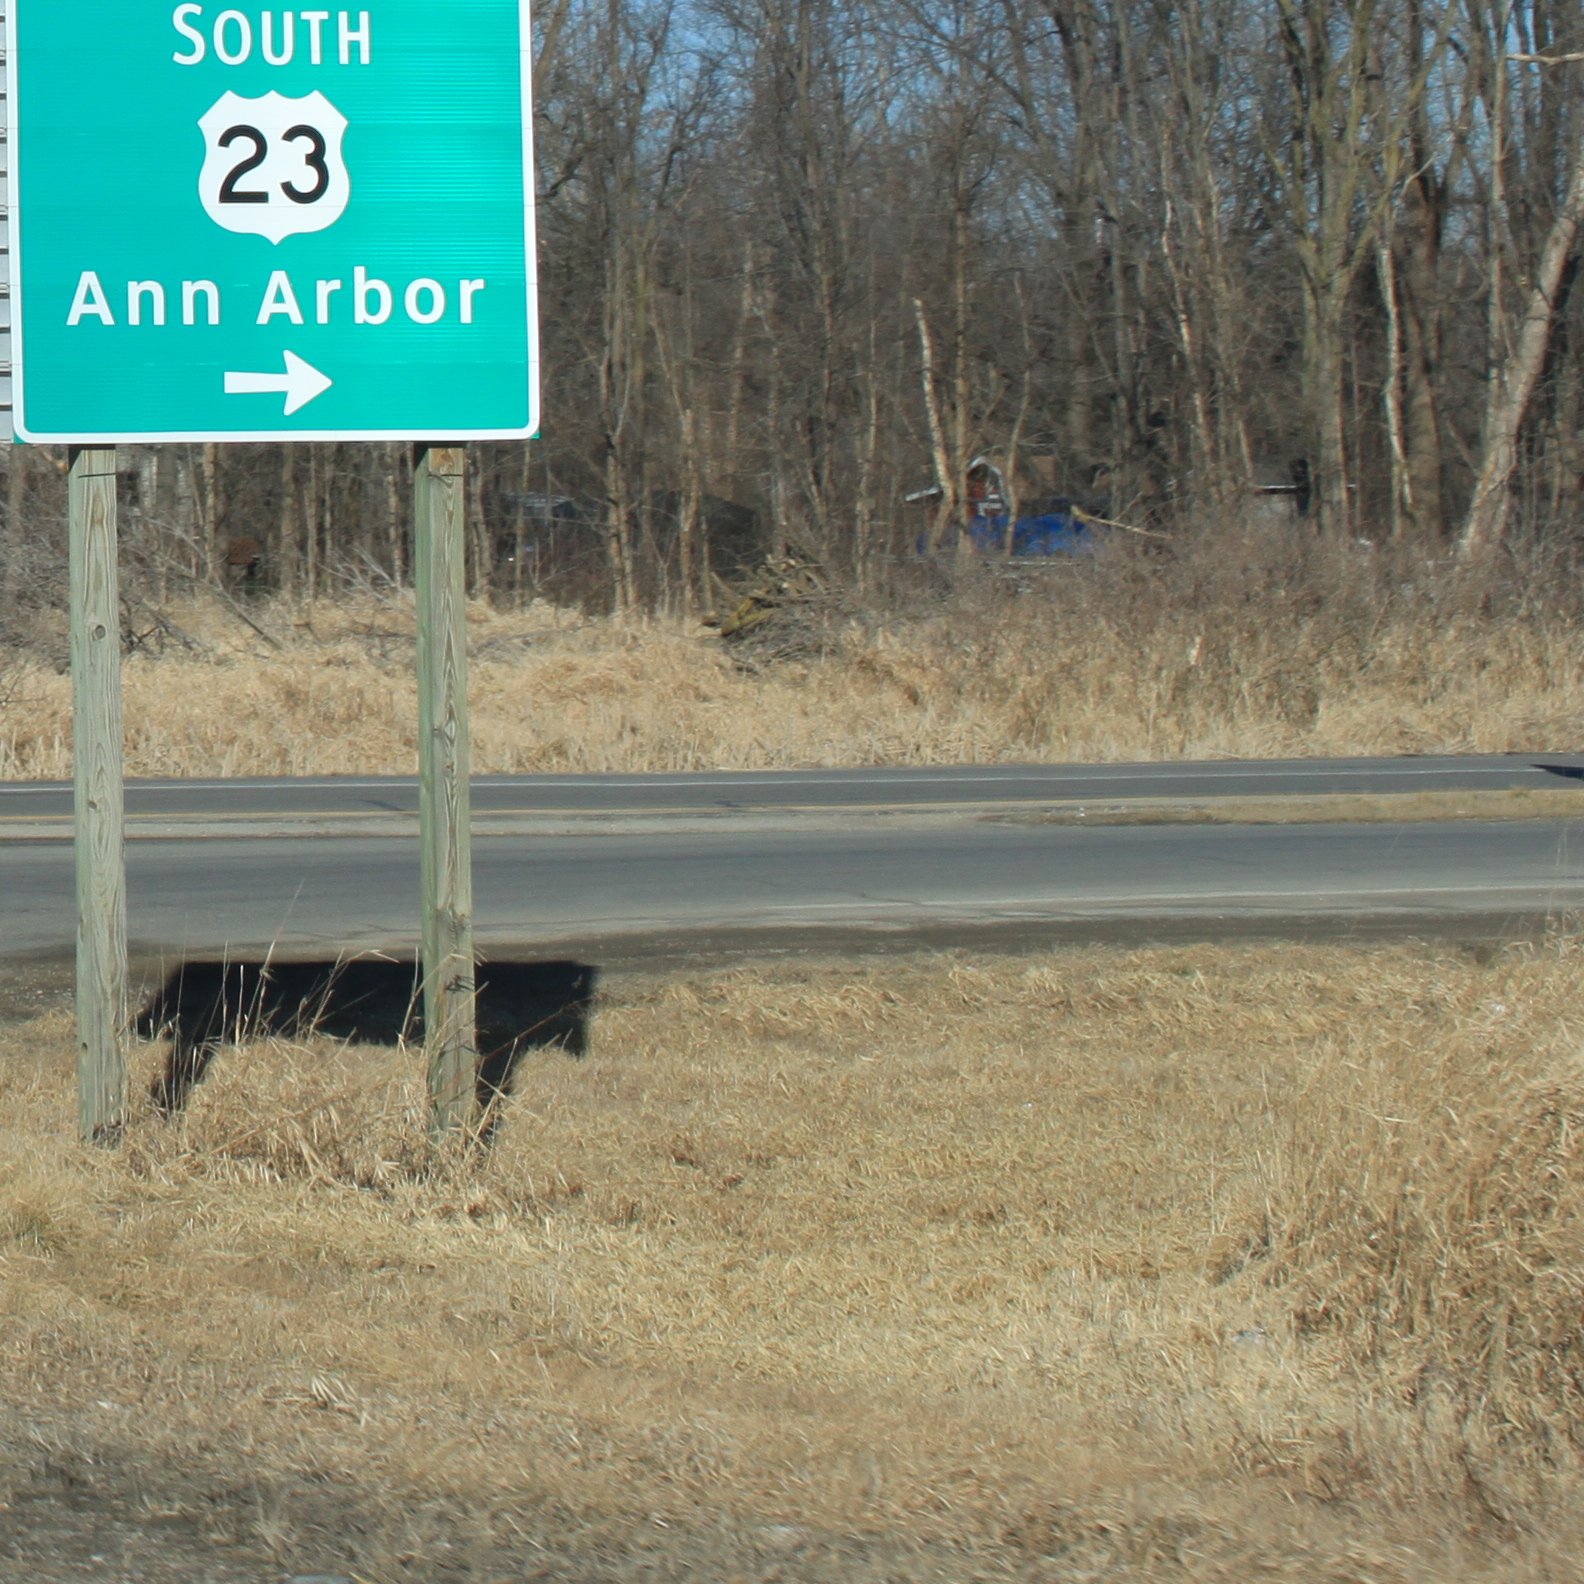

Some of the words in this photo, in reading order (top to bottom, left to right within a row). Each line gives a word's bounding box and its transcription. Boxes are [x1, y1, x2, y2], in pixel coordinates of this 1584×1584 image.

[172, 2, 372, 66] SOUTH
[217, 123, 330, 204] 23
[66, 270, 220, 326] Ann
[256, 265, 486, 326] Arbor
